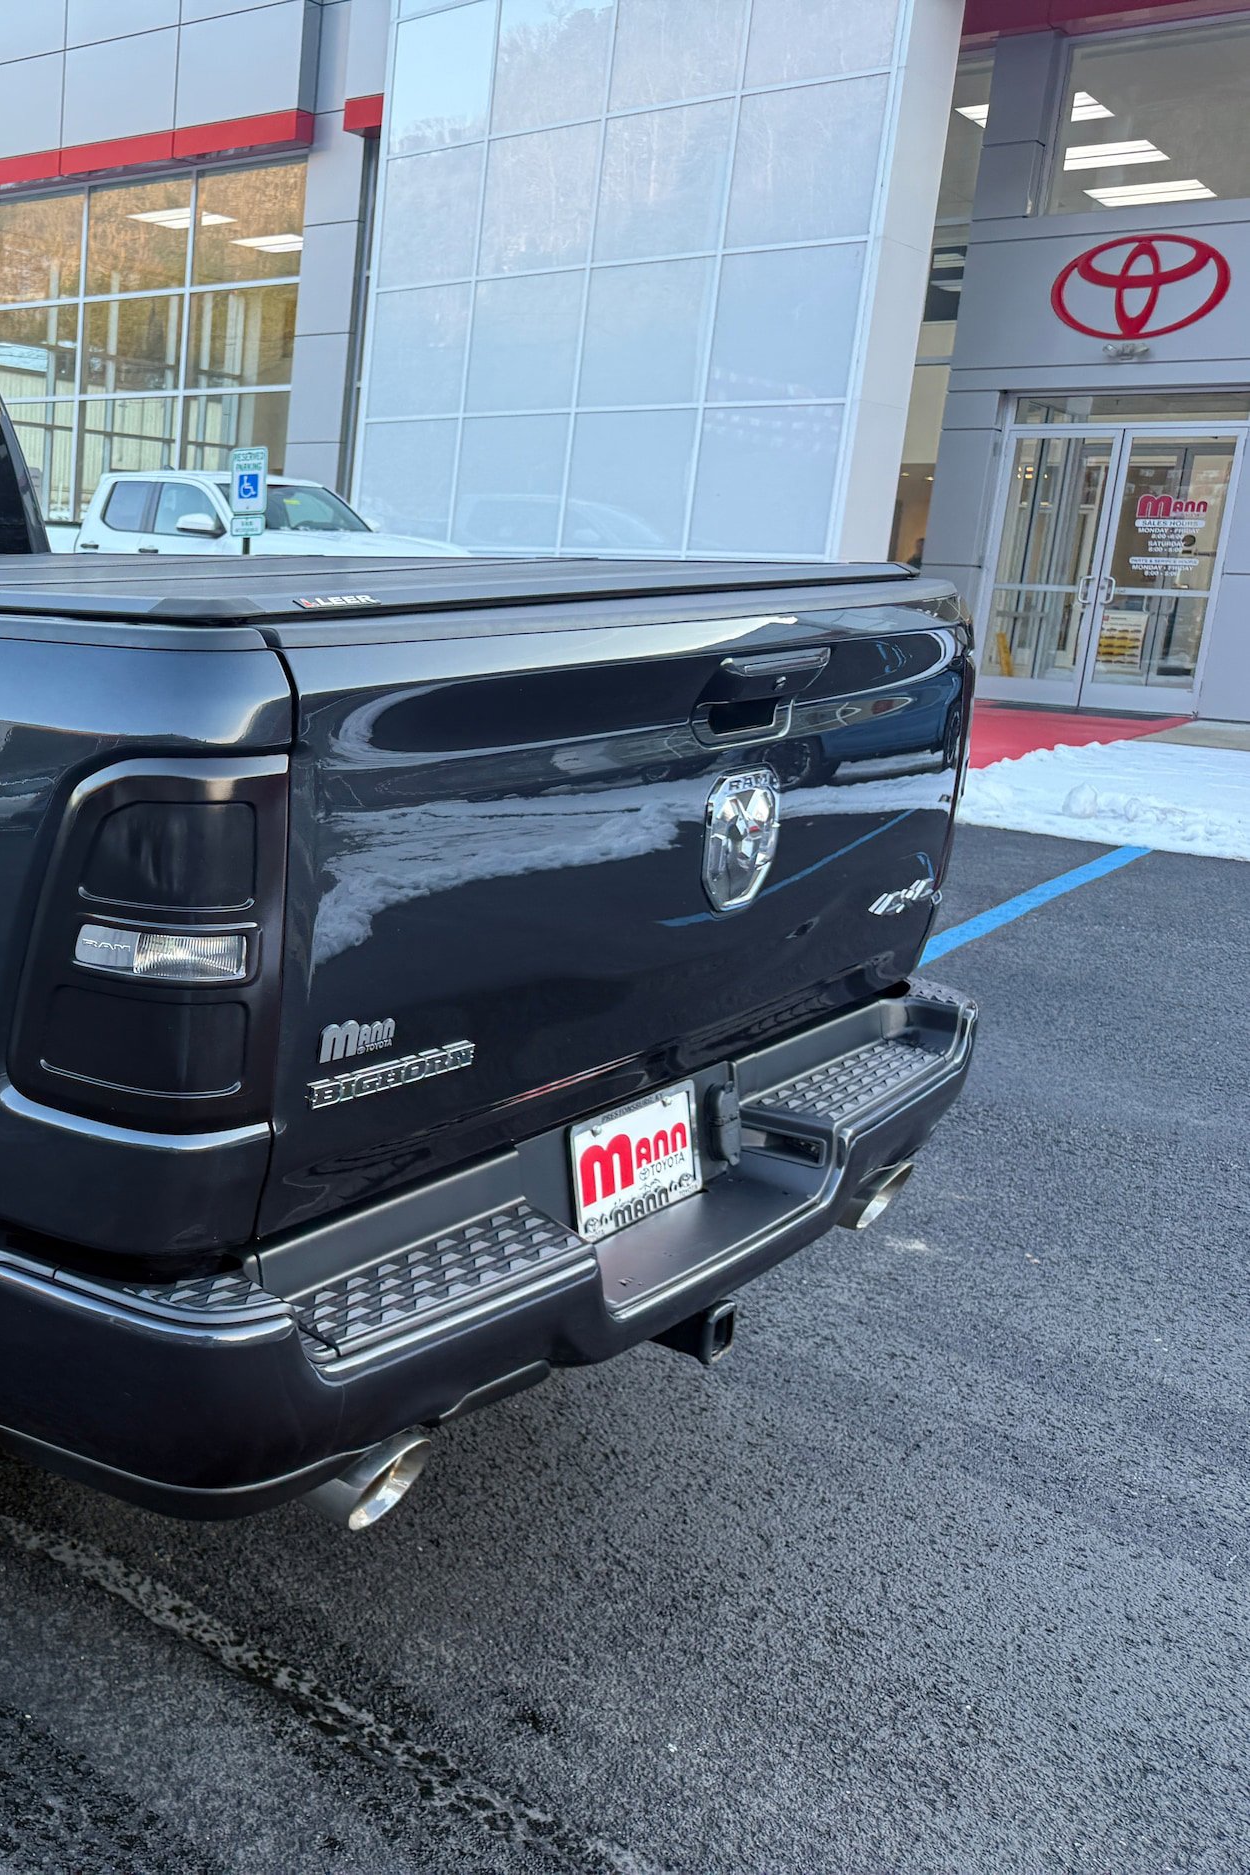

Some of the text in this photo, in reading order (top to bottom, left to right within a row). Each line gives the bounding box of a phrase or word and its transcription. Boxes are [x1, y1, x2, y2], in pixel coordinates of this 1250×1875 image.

[315, 594, 378, 606] LEER
[729, 773, 771, 793] RAM
[82, 938, 131, 953] RAM
[365, 1038, 393, 1053] TOYOTA
[651, 1152, 685, 1176] TOYOTA
